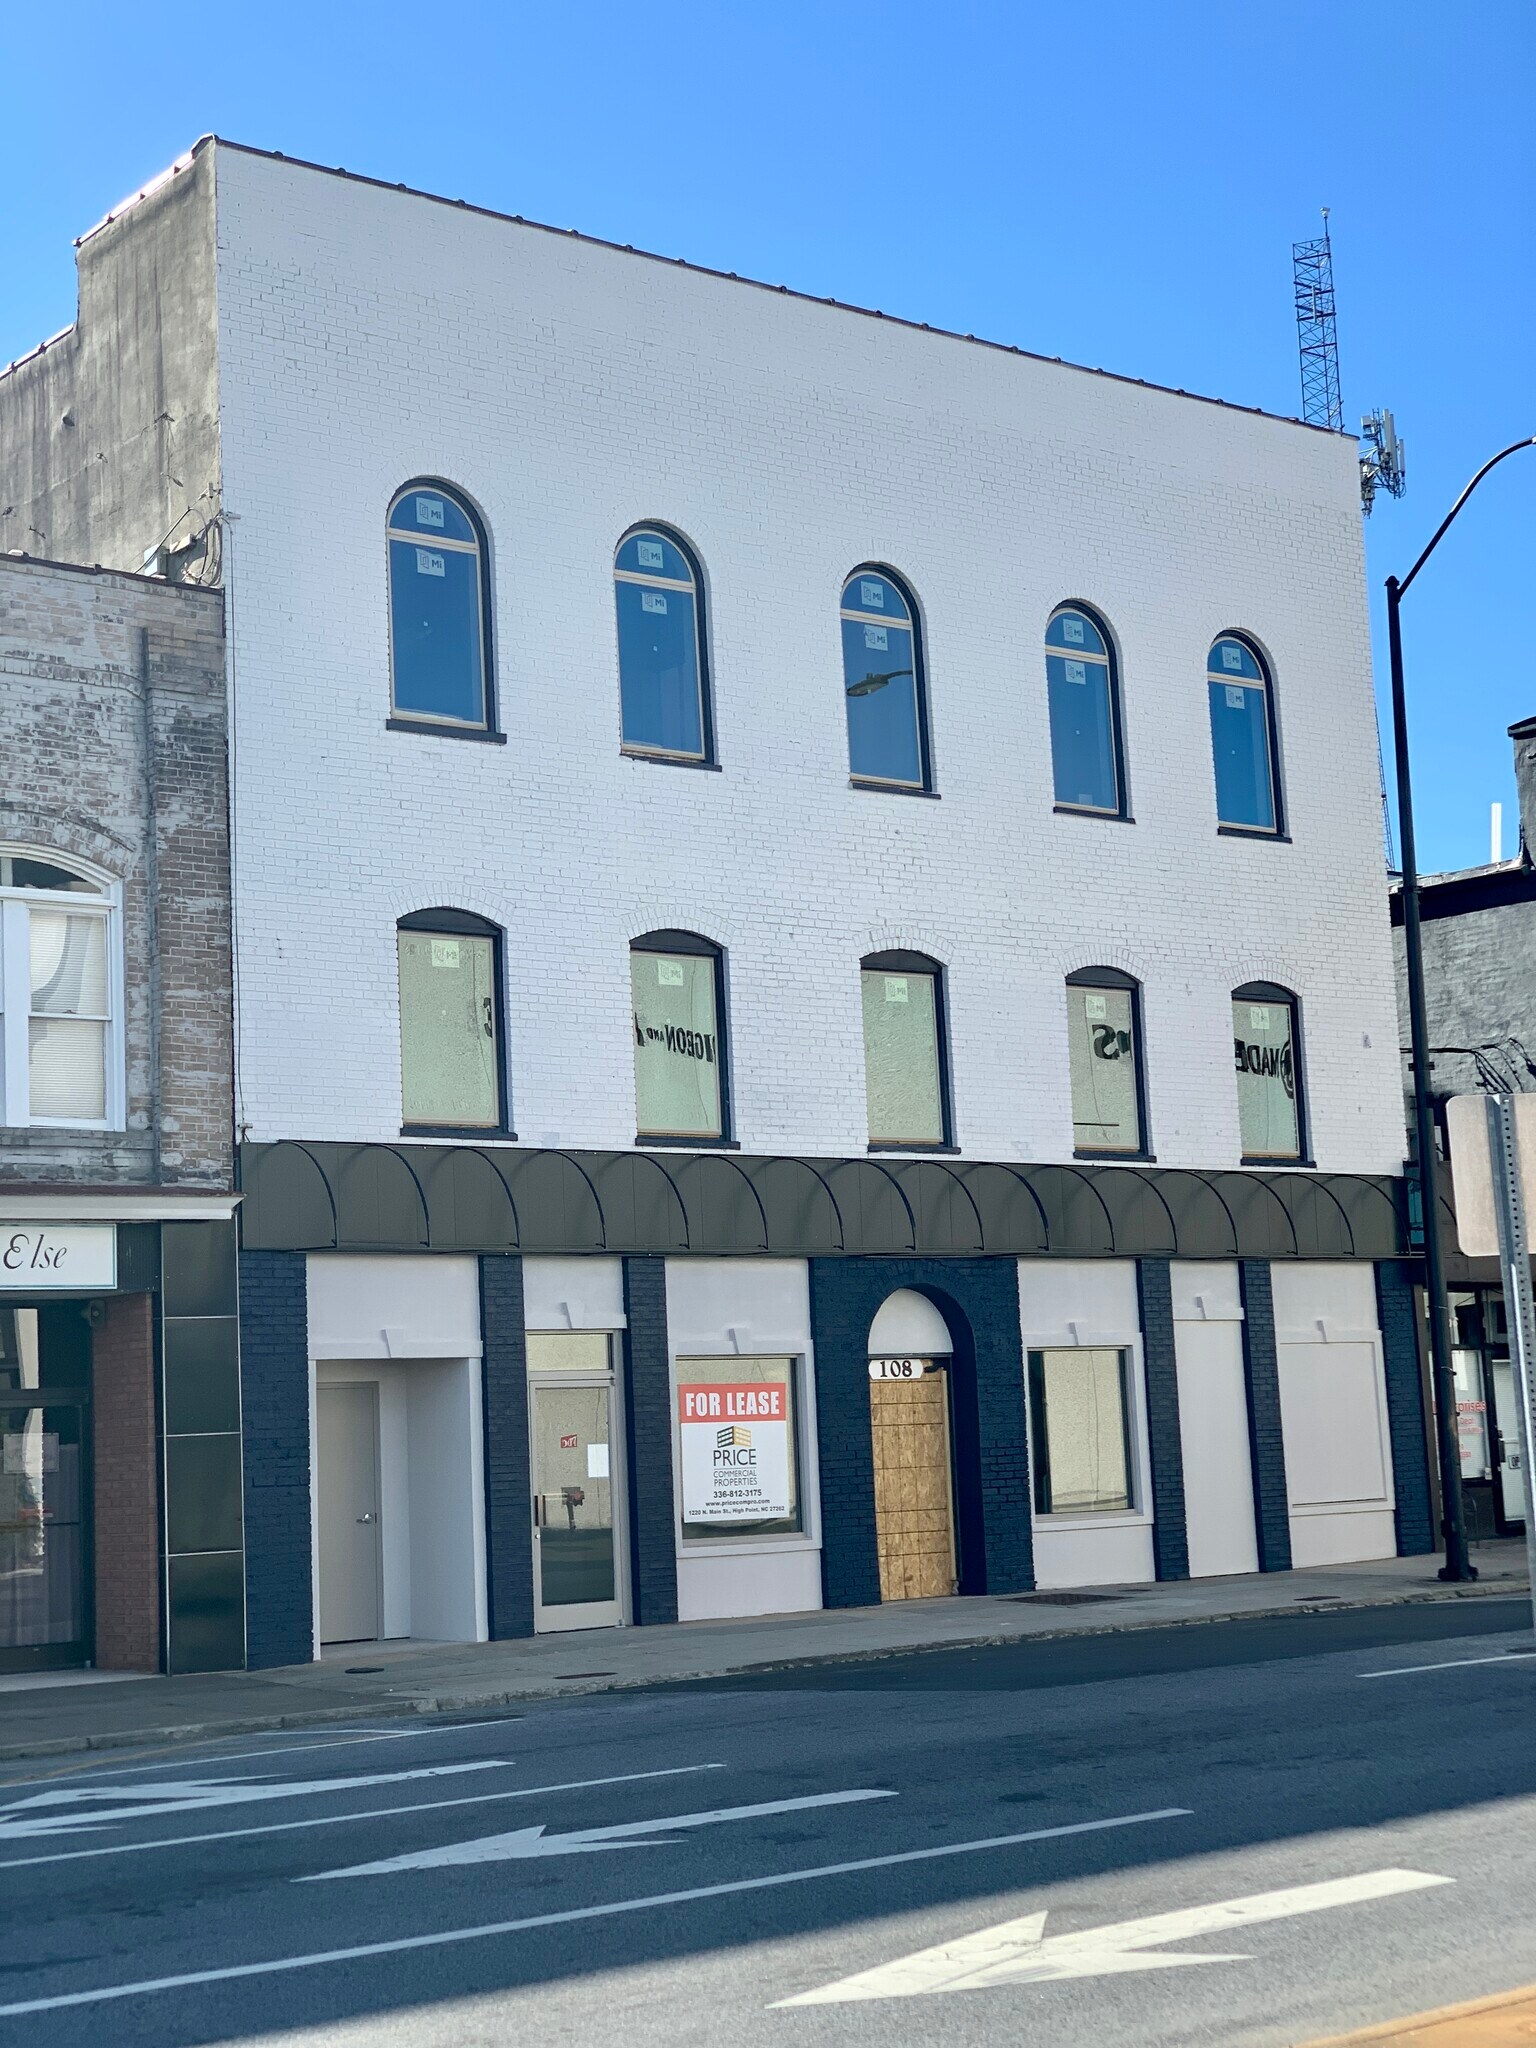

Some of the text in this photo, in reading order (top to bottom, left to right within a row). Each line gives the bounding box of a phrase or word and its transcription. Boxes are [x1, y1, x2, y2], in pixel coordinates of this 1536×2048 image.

[3, 1233, 67, 1269] Else
[880, 1360, 912, 1377] 108
[685, 1391, 780, 1417] FOR LEASE
[713, 1449, 757, 1466] PRICE
[713, 1469, 757, 1478] COMMERCIAL
[713, 1477, 758, 1487] PROPERTIES
[713, 1489, 762, 1498] 336-812-3175
[705, 1499, 770, 1507] www.pricecompro.com
